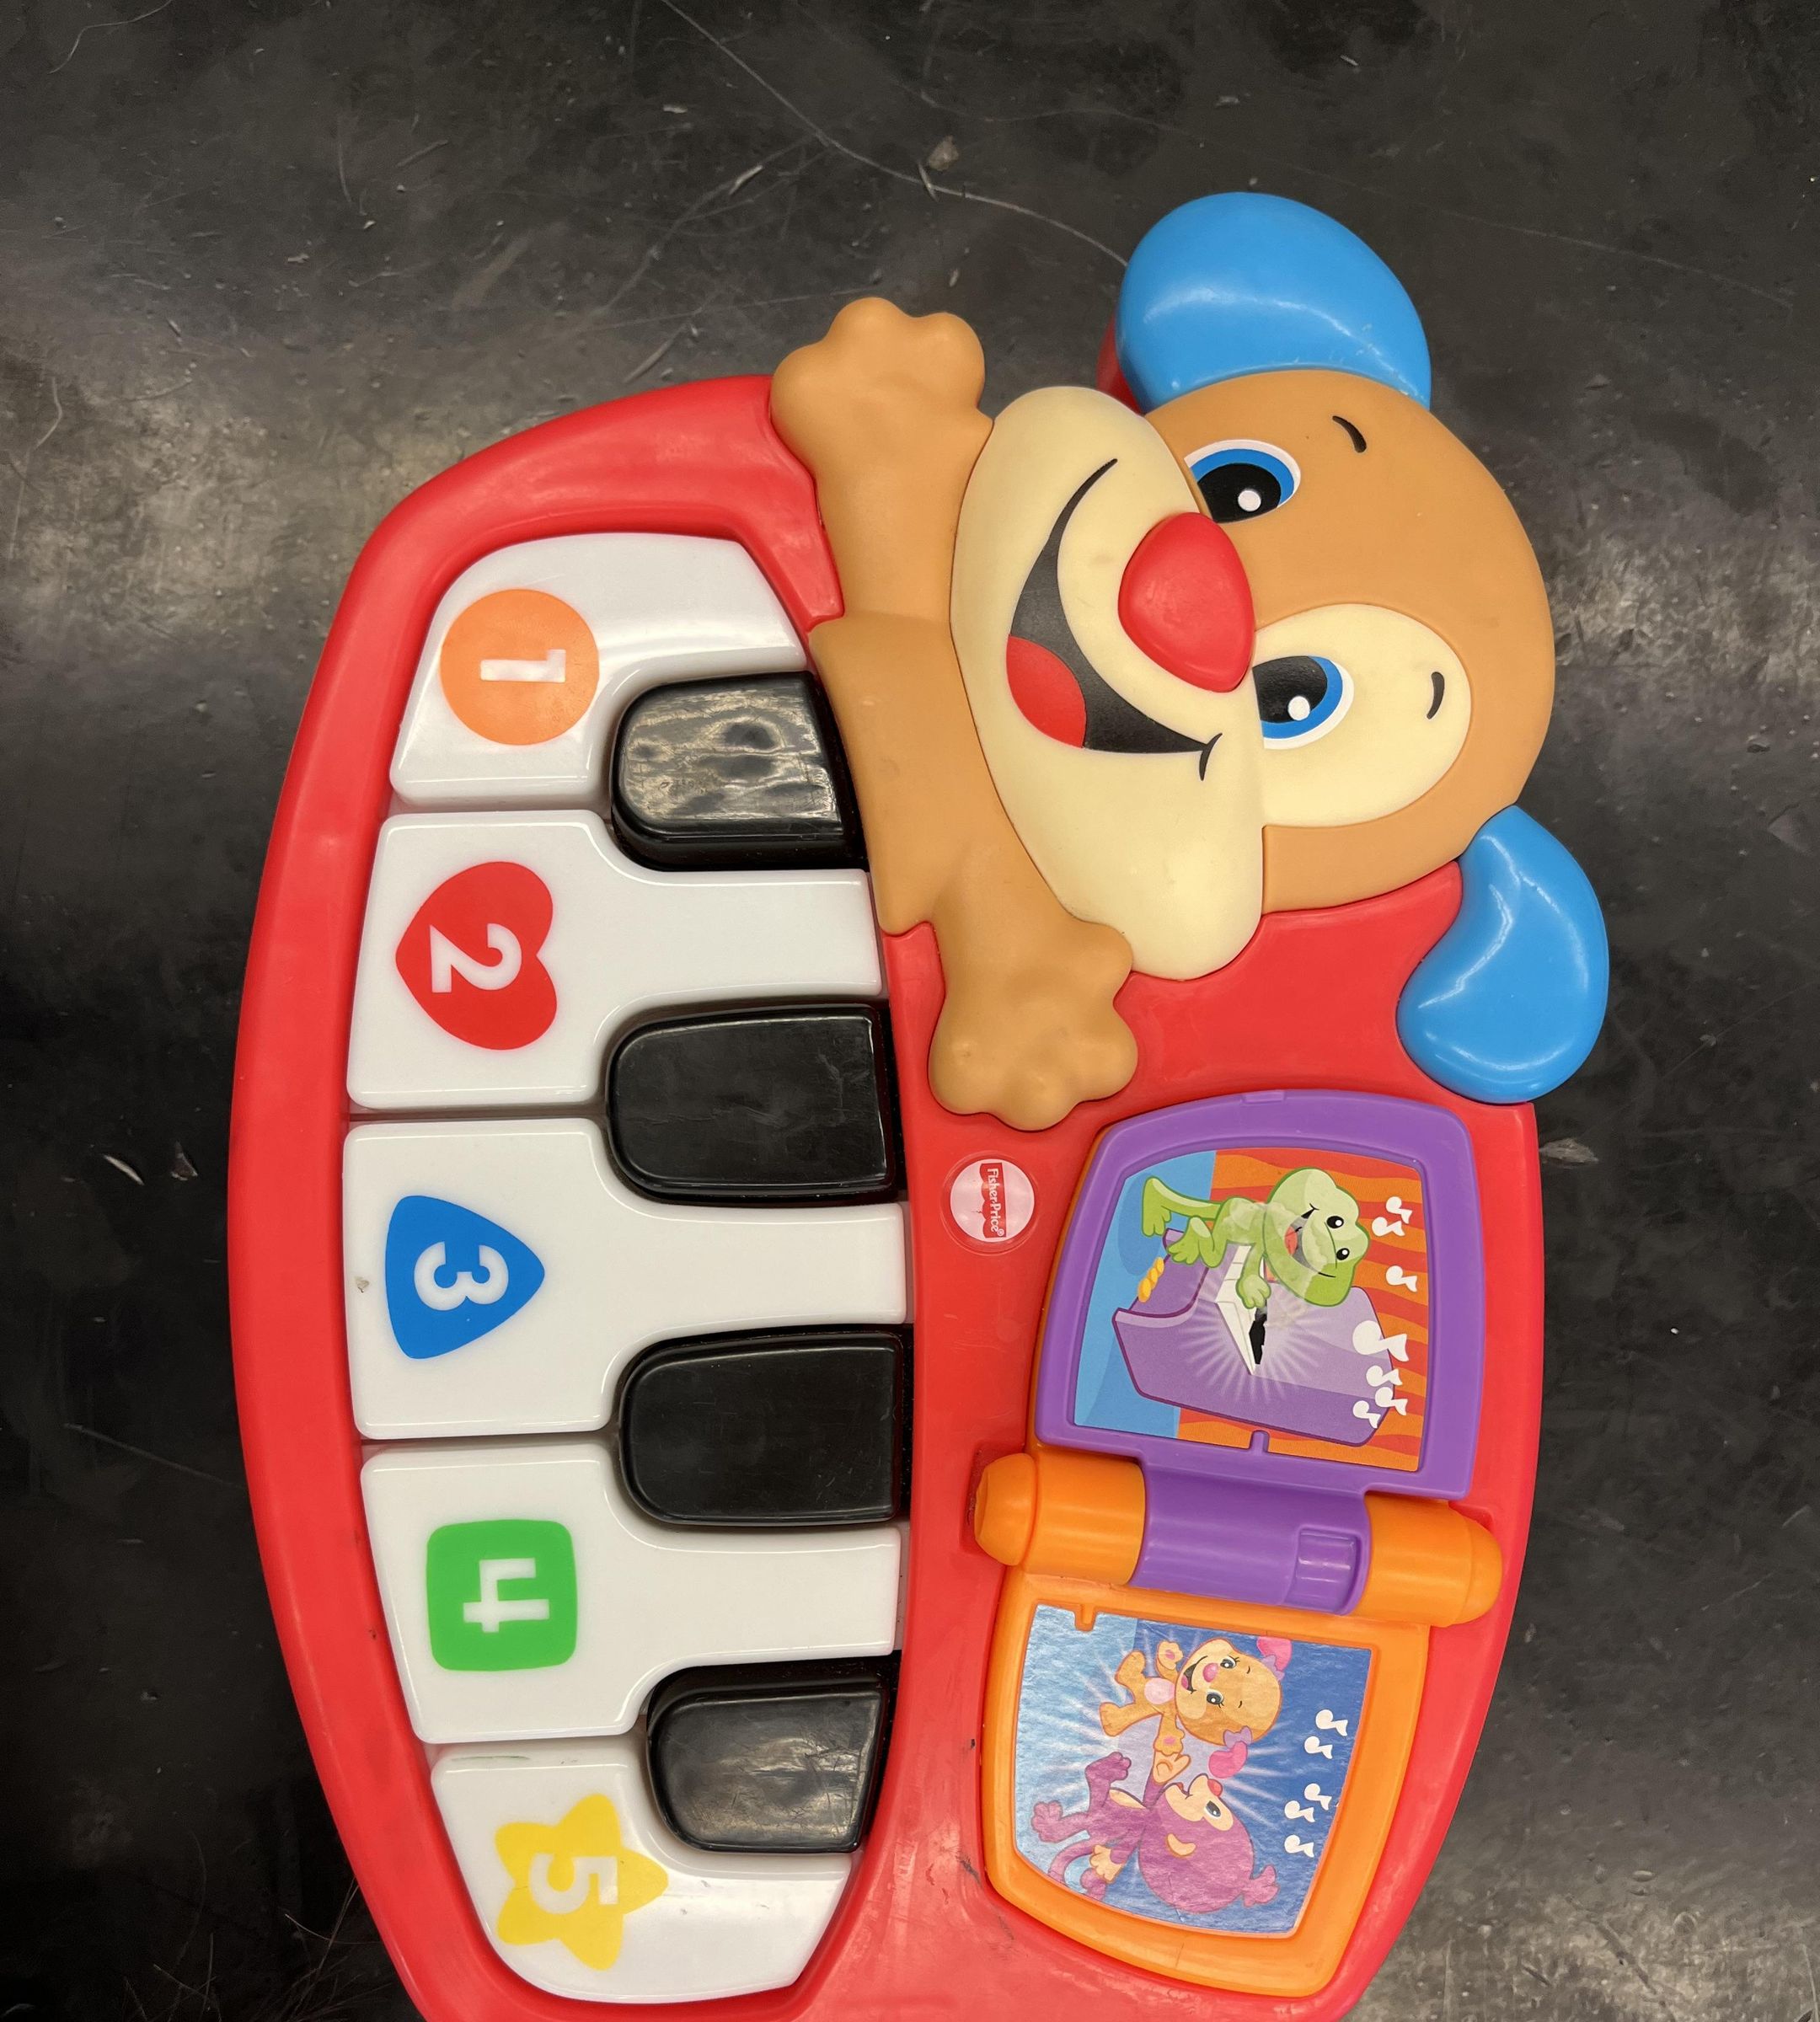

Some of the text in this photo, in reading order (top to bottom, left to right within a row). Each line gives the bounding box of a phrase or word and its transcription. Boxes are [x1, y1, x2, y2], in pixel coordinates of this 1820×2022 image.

[480, 649, 566, 683] 1
[429, 923, 522, 993] 2
[413, 1241, 509, 1311] 3
[463, 1558, 550, 1634] 4
[528, 1851, 619, 1917] 5
